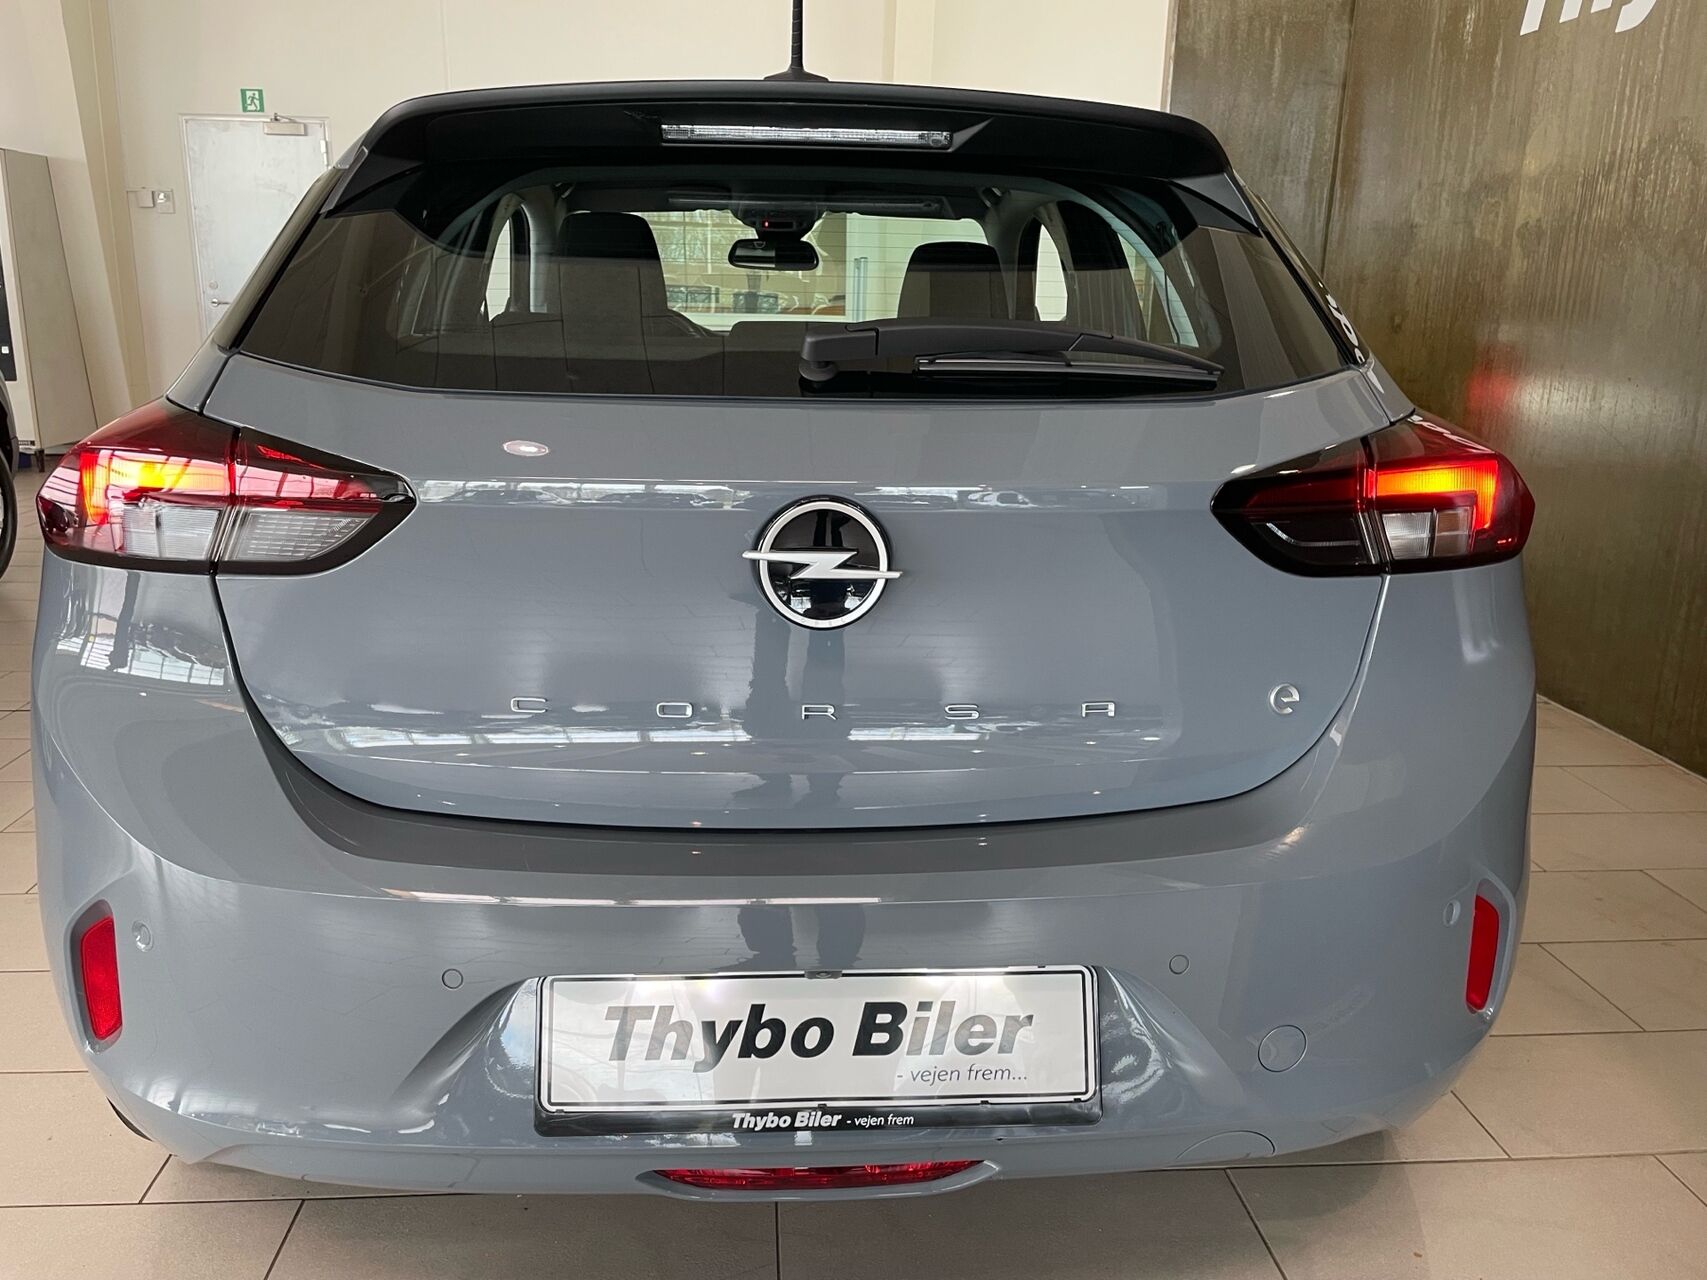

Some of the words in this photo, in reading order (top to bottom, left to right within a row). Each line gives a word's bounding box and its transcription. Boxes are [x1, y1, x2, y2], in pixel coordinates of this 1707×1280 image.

[509, 696, 1116, 721] CORSA
[605, 1003, 835, 1073] Thybo
[852, 1000, 1034, 1056] Biler
[910, 1066, 960, 1086] vejen
[967, 1063, 1027, 1082] frem...
[732, 1112, 791, 1131] Thybo
[794, 1111, 842, 1128] Biler
[854, 1115, 885, 1129] vejen
[887, 1113, 914, 1126] frem
